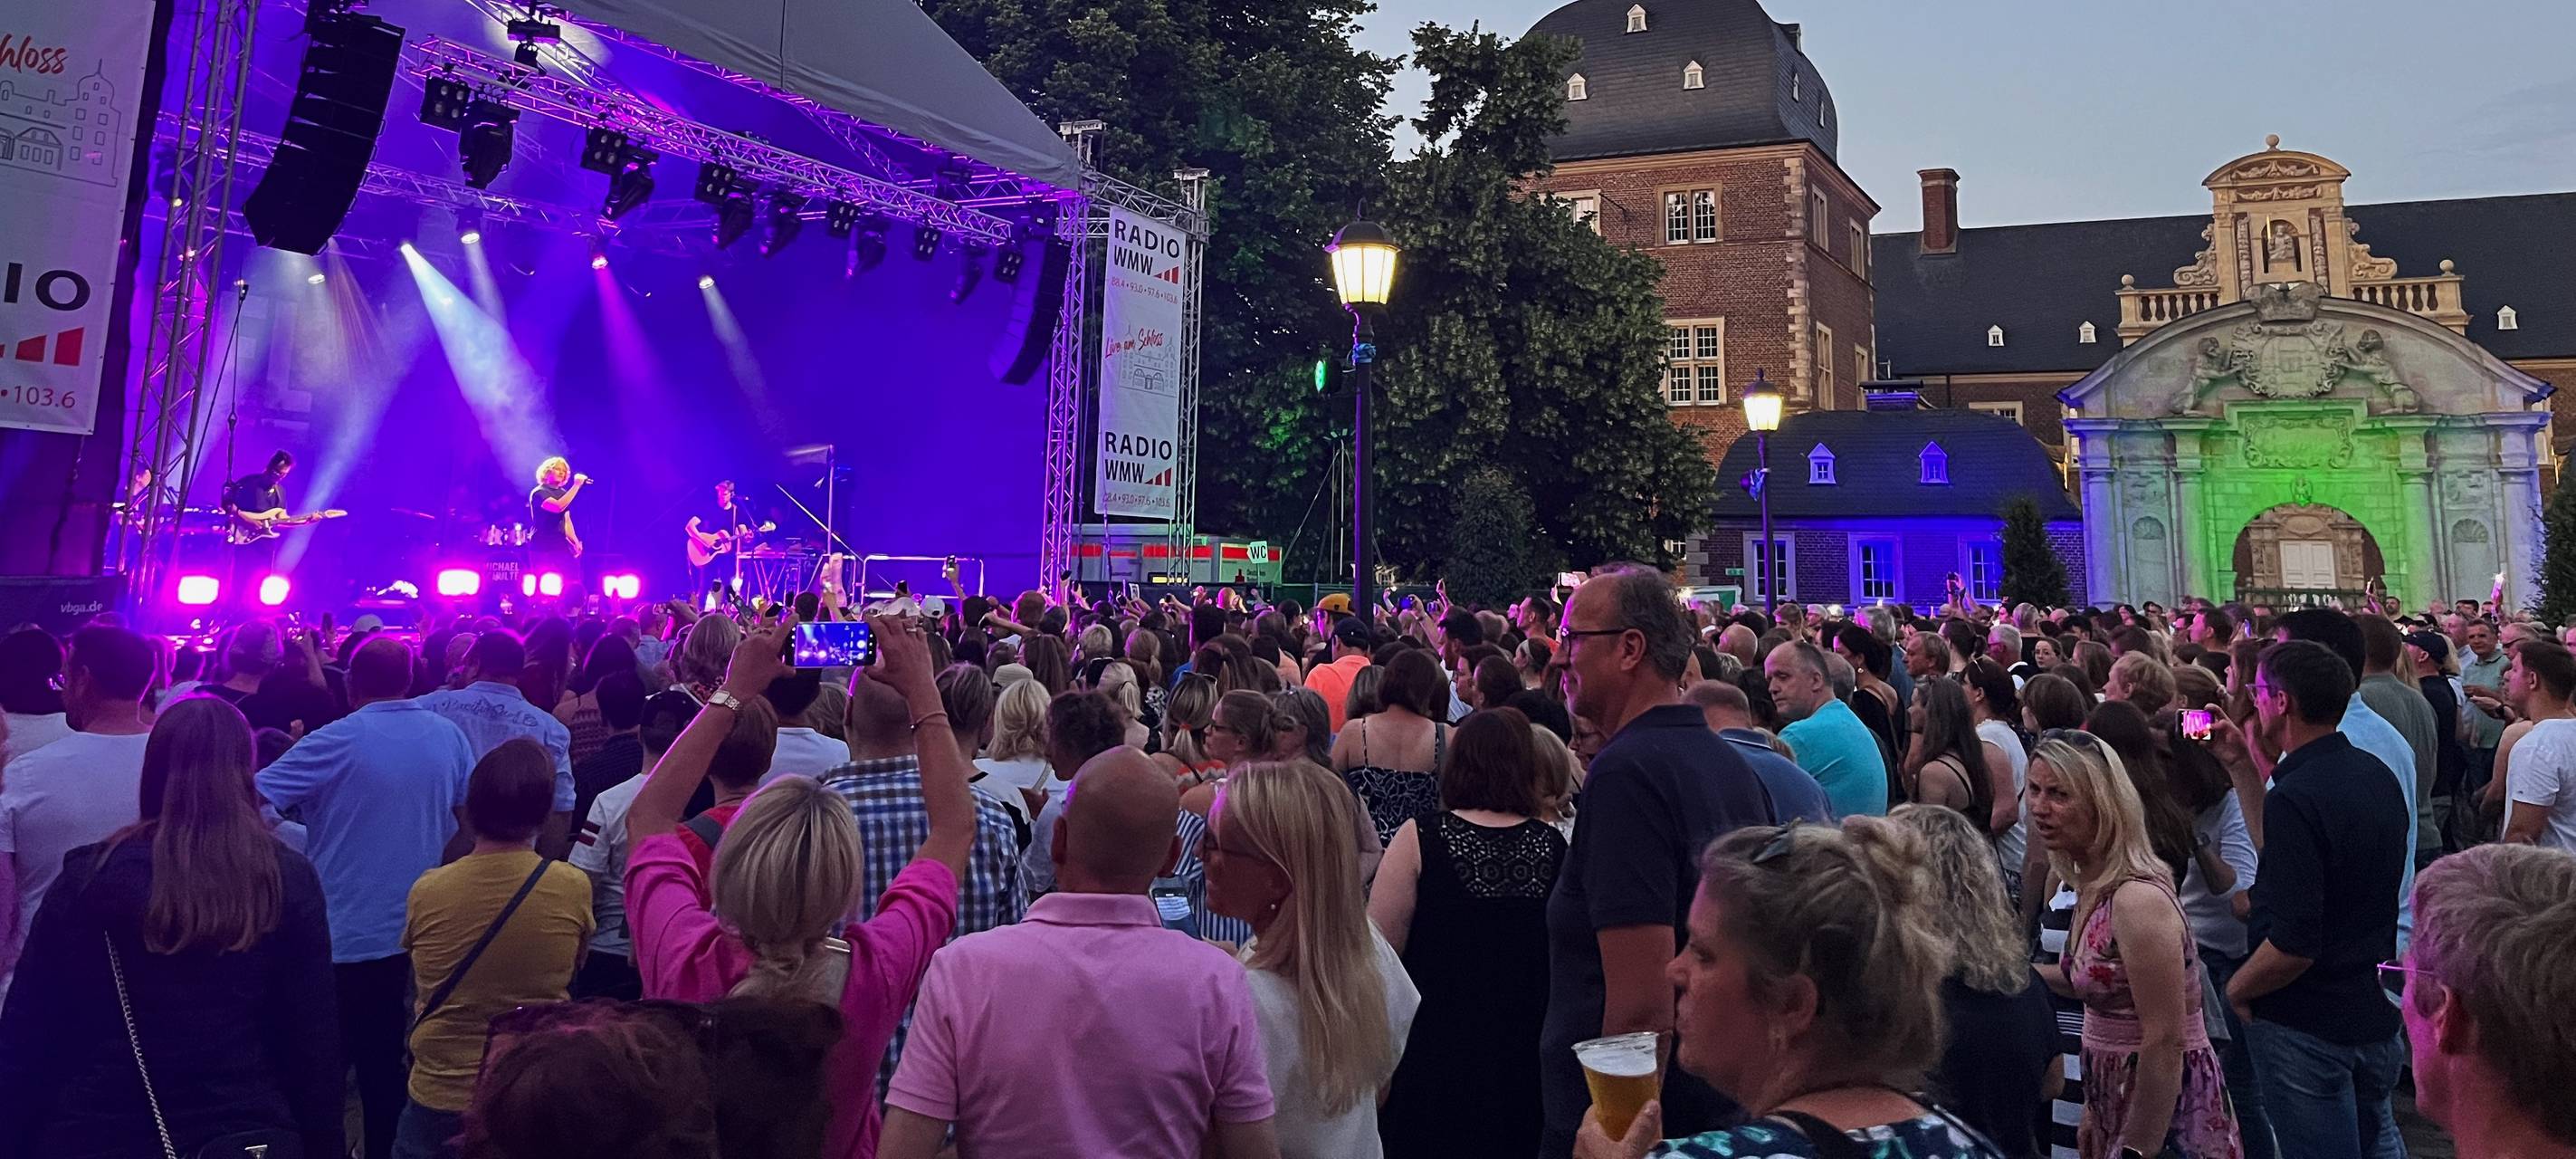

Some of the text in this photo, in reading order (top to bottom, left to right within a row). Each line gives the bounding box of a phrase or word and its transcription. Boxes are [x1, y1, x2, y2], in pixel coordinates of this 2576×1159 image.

[1115, 219, 1179, 258] RADIO
[1114, 245, 1153, 275] WMW
[1105, 328, 1163, 359] Live am Schloss
[1105, 431, 1172, 460] RADIO
[1105, 459, 1144, 484] WMW
[1250, 545, 1266, 560] WC
[61, 600, 103, 615] vbga.de
